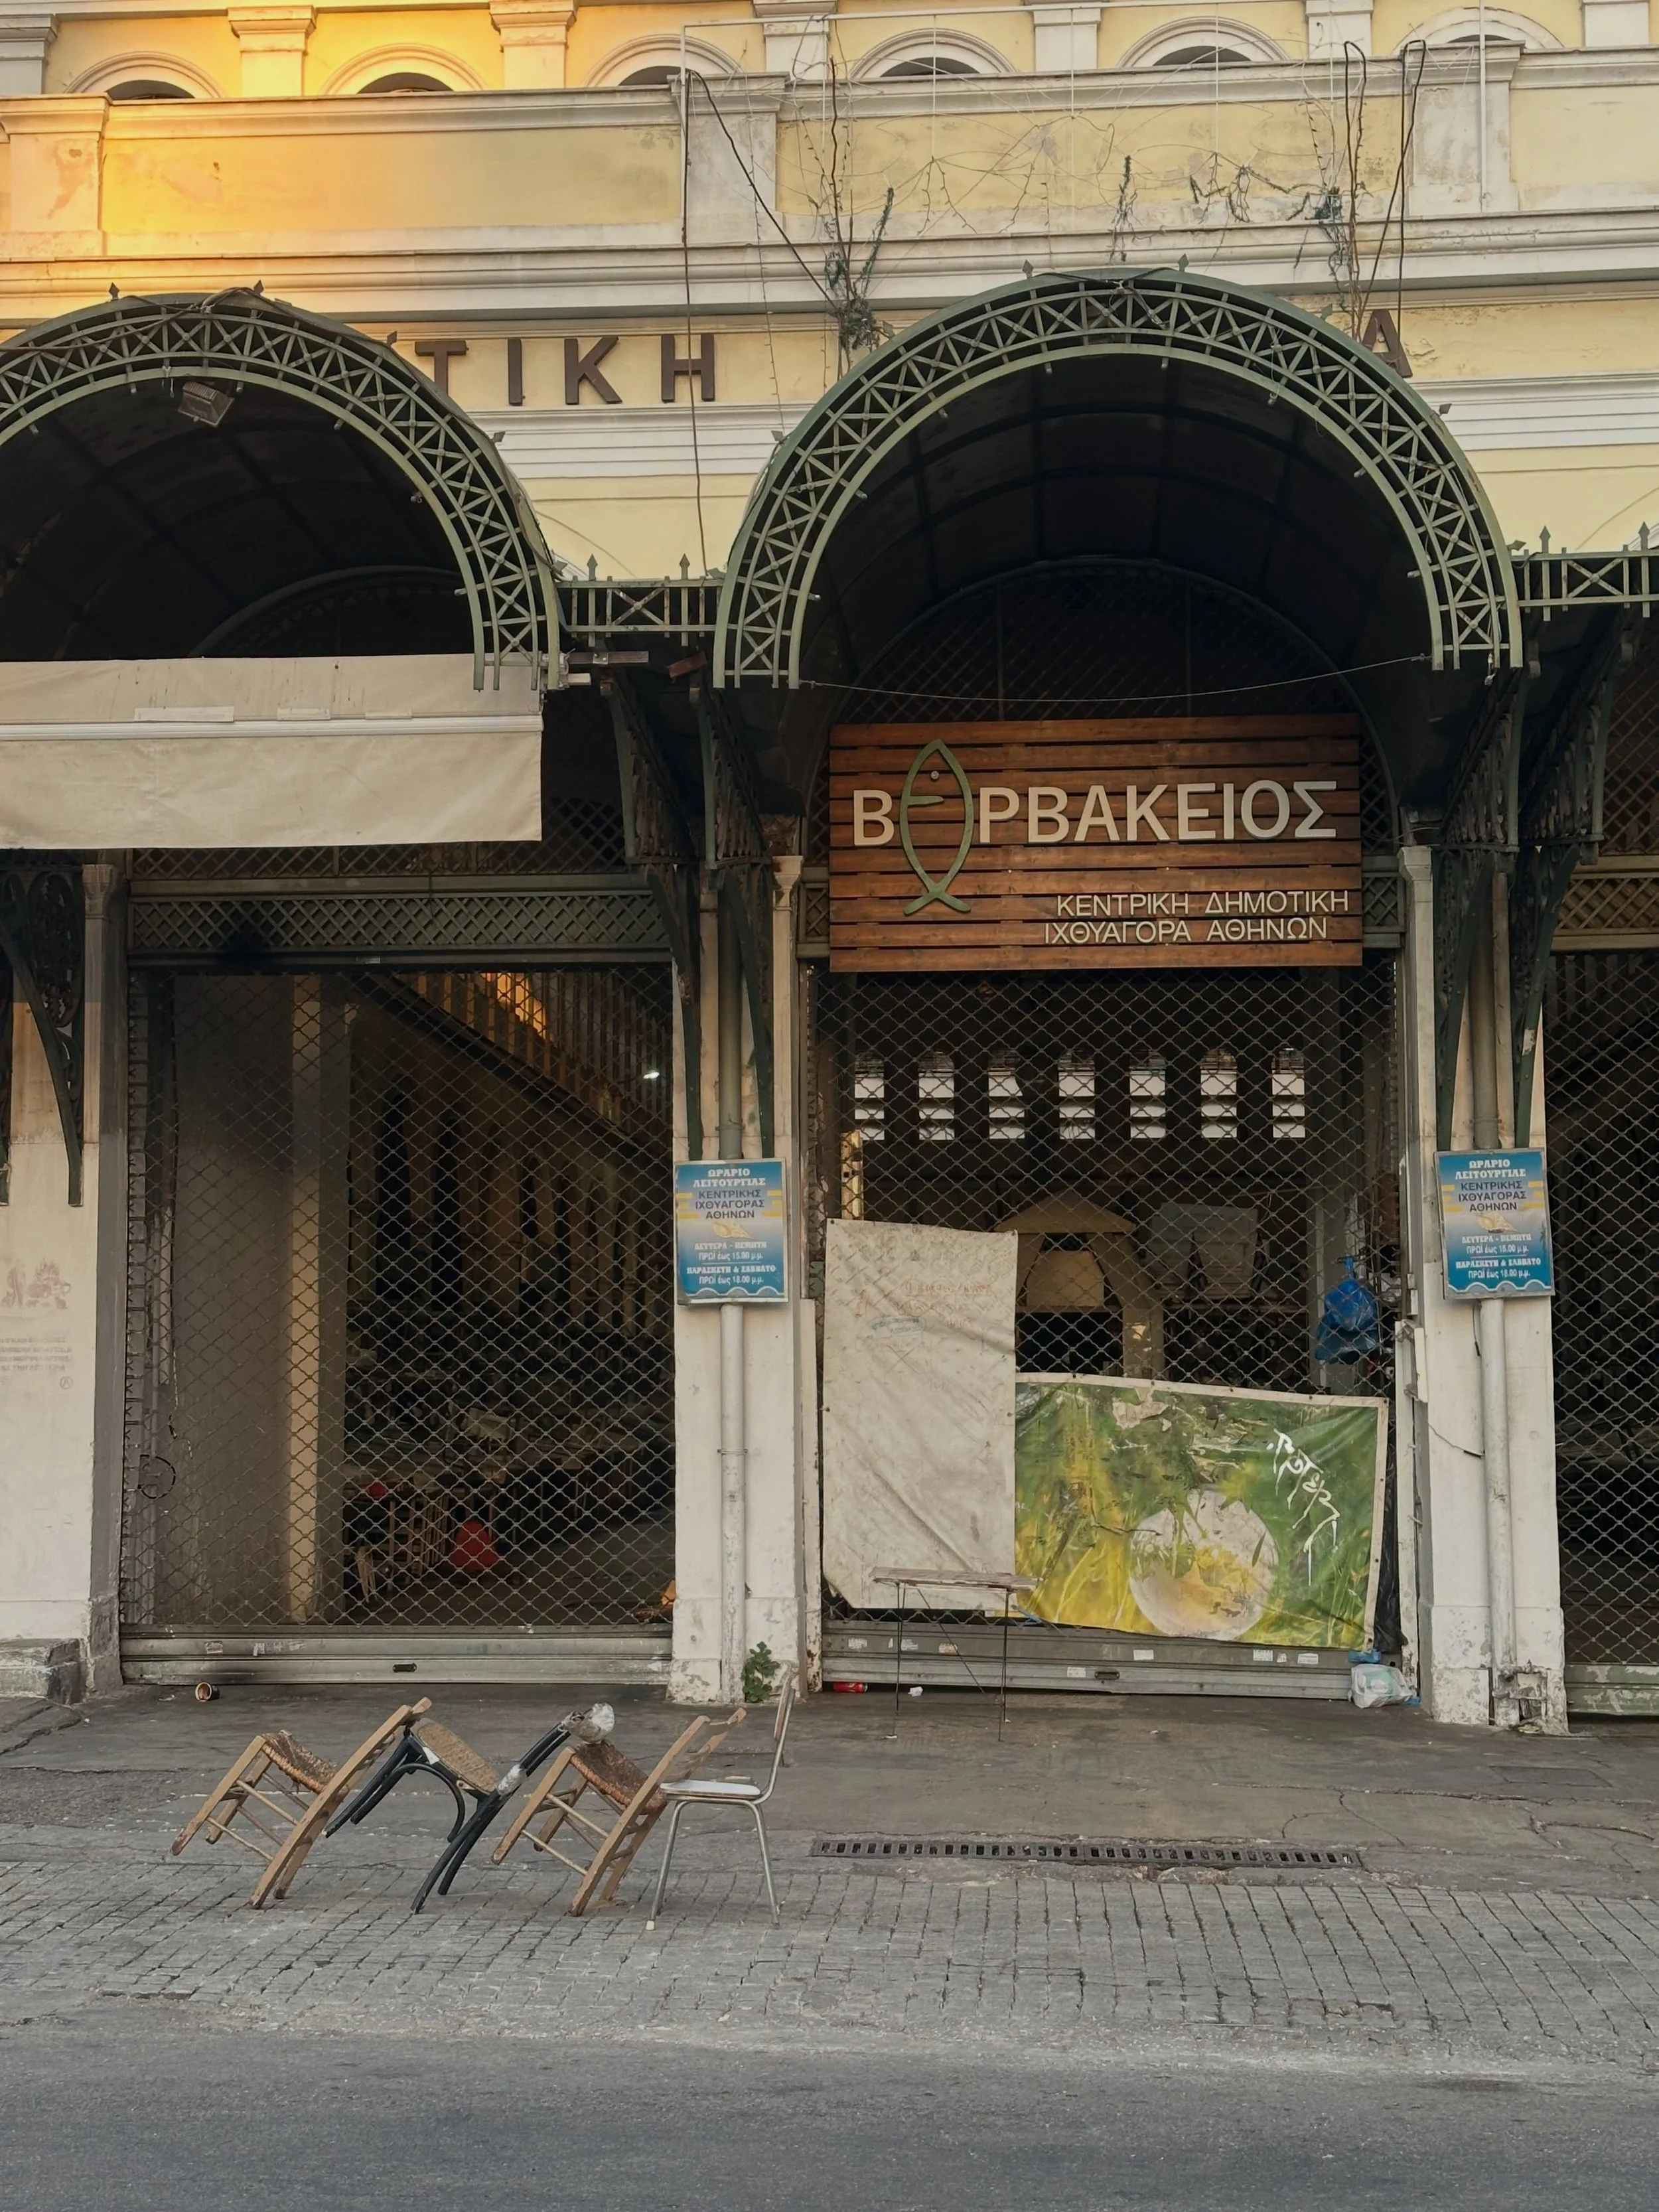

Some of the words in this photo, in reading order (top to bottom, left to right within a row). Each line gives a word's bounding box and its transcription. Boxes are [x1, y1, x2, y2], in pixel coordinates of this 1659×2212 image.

[1056, 893, 1189, 917] ΚΕΝΤΡΙΚΗ
[1205, 890, 1349, 914] ΔΗΜΟΤΙΚΗ
[1045, 920, 1192, 945] ΙΧΘΥΑΓΟΡΑ
[1206, 917, 1327, 942] ΑΘΗΝΩΝ
[1469, 1159, 1510, 1168] ΩΡΑΡΙΟ
[1455, 1169, 1526, 1179] ΛΕΙΤΟΥΡΓΙΑΣ
[693, 1178, 766, 1187] ΛΕΙΤΟΥΡΓΙΑΣ
[1461, 1181, 1522, 1191] ΚΕΝΤΡΙΚΗΣ
[699, 1189, 761, 1199] ΚΕΝΤΡΙΚΗΣ
[1459, 1191, 1526, 1202] ΙΧΘΥΑΓΟΡΑΣ
[695, 1199, 764, 1209] ΙΧΘΥΑΓΟΡΑΣ
[1469, 1202, 1517, 1212] ΑΘΗΝΩΝ
[706, 1210, 755, 1219] ΑΘΗΝΩΝ
